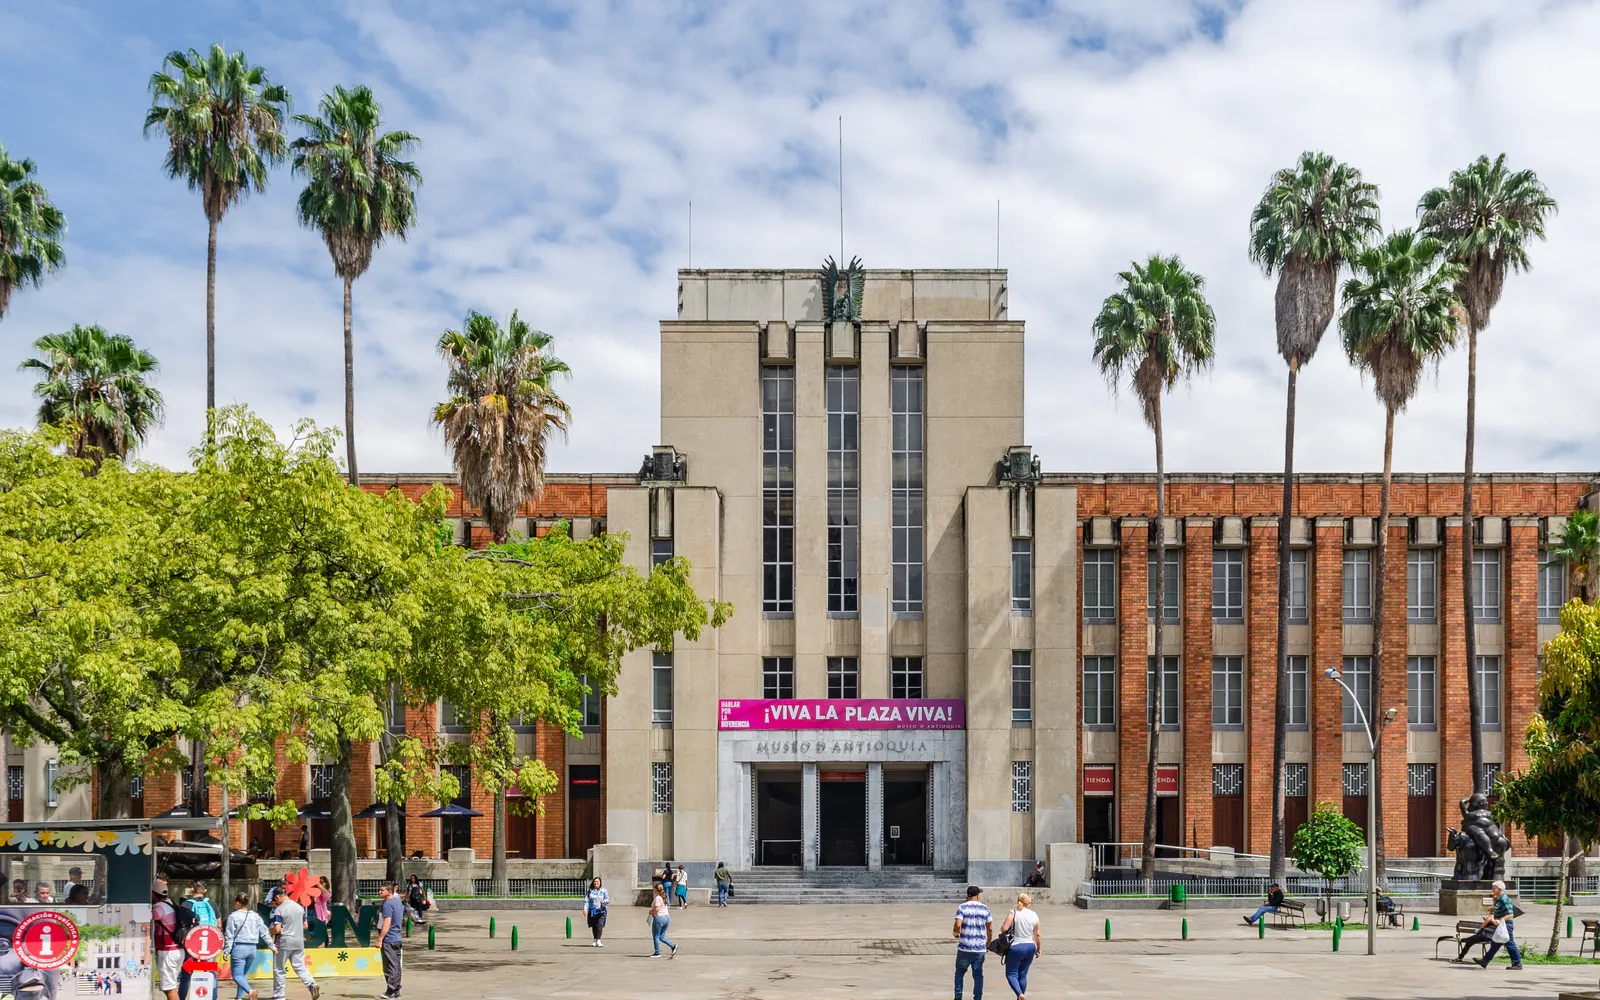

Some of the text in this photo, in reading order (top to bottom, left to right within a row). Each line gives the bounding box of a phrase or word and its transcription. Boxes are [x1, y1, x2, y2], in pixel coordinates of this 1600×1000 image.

[720, 707, 732, 715] POR
[764, 705, 953, 724] ¡VIVA LA PLAZA VIVA!
[756, 740, 811, 754] MUSEO
[831, 740, 928, 754] ANTIOQUIA
[15, 912, 78, 939] INFORMACIÓN TURÍSTICA
[16, 946, 76, 968] TOURIST INFORMATION
